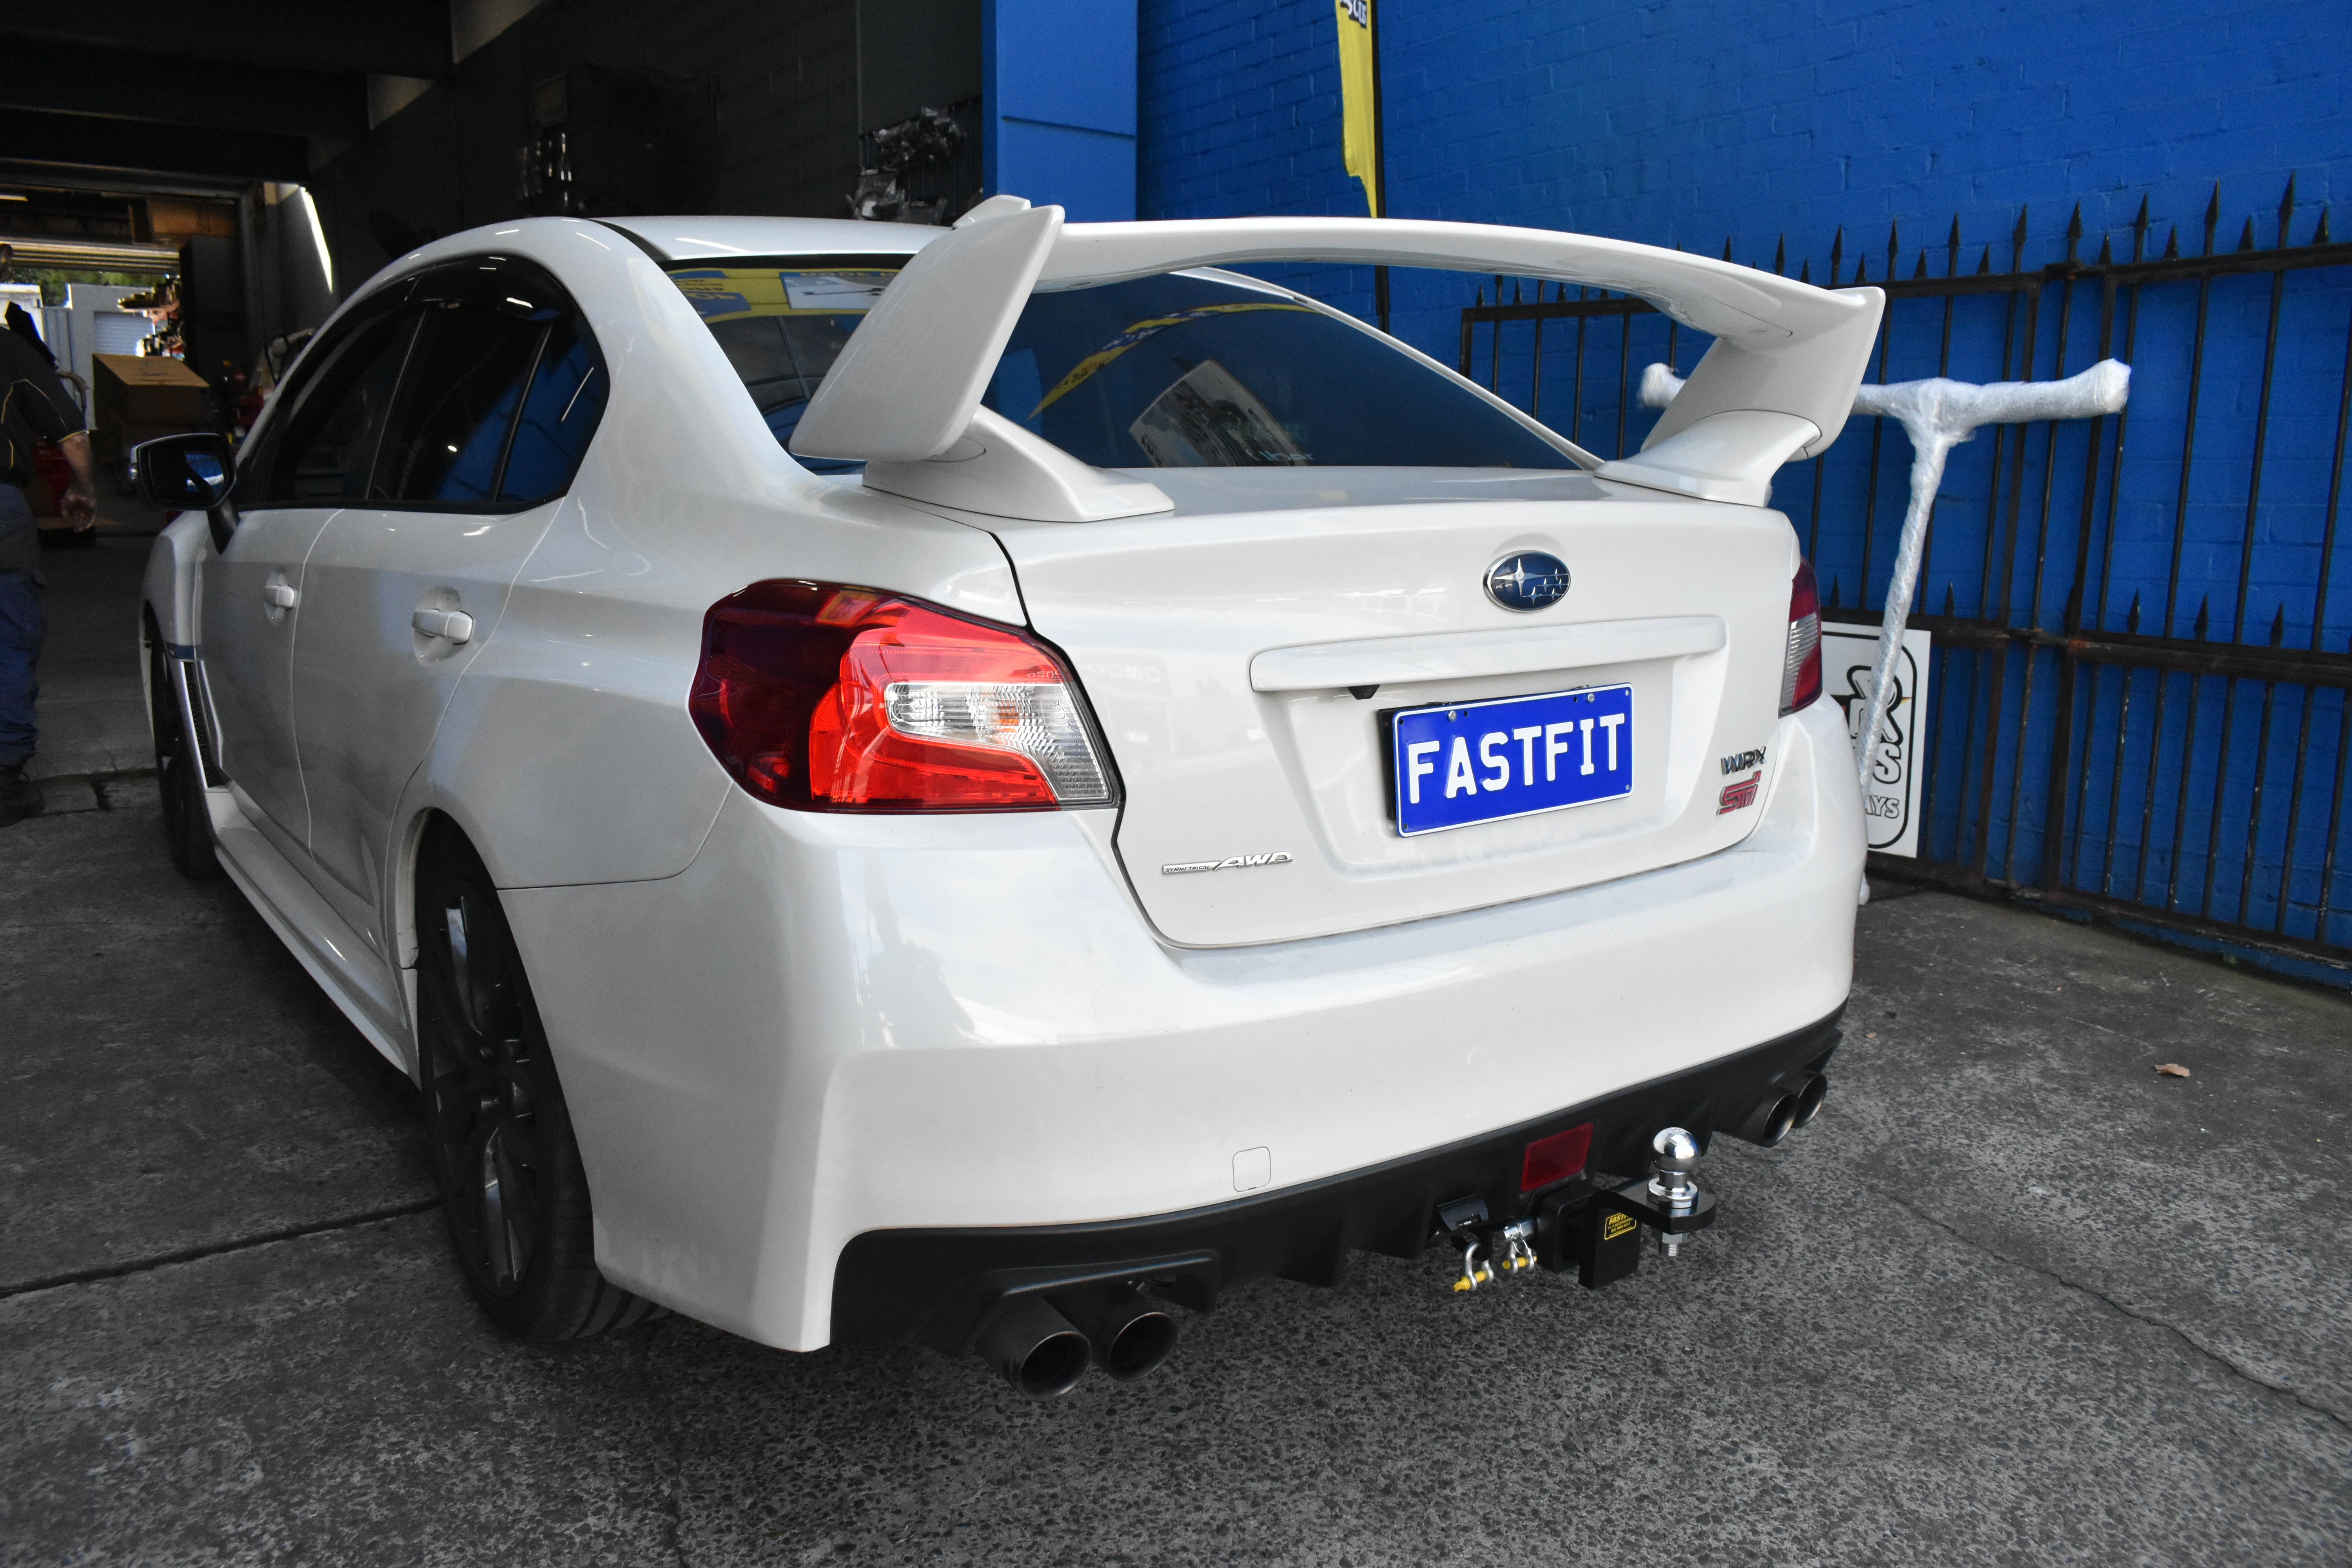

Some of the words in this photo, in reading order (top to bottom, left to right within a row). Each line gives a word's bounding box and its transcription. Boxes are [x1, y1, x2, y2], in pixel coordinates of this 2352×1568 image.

[1408, 713, 1625, 804] FASTFIT
[1721, 746, 1766, 775] WRX
[1213, 851, 1293, 870] AWD
